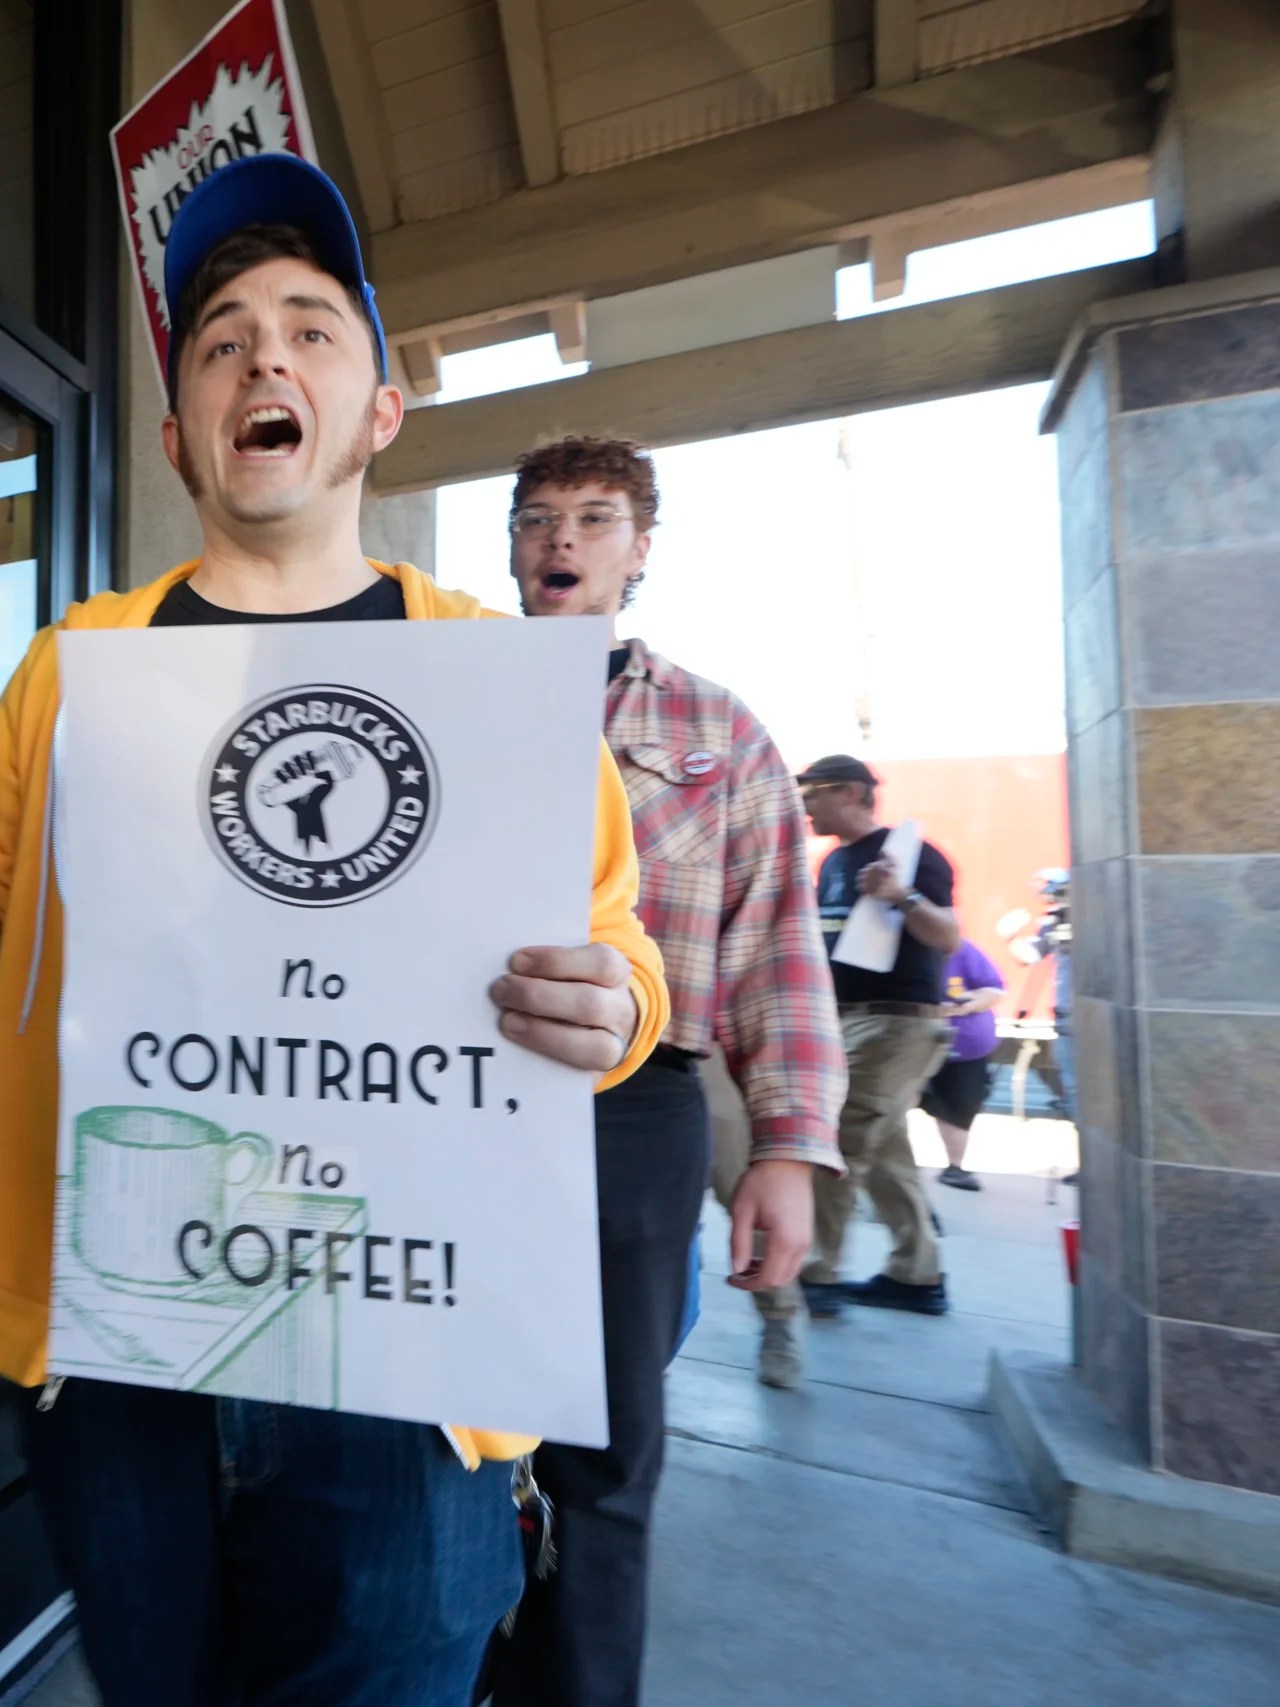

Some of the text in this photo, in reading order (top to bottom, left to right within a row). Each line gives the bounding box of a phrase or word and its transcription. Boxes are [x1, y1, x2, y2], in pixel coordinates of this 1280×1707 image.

[178, 125, 215, 169] OUR
[232, 700, 411, 761] STARBUCKS
[210, 791, 315, 888] WORKERS
[340, 796, 425, 882] UNITED
[280, 958, 347, 1000] no
[127, 1031, 519, 1114] CONTRACT,
[278, 1144, 345, 1188] no
[178, 1220, 457, 1307] COFFEE!
